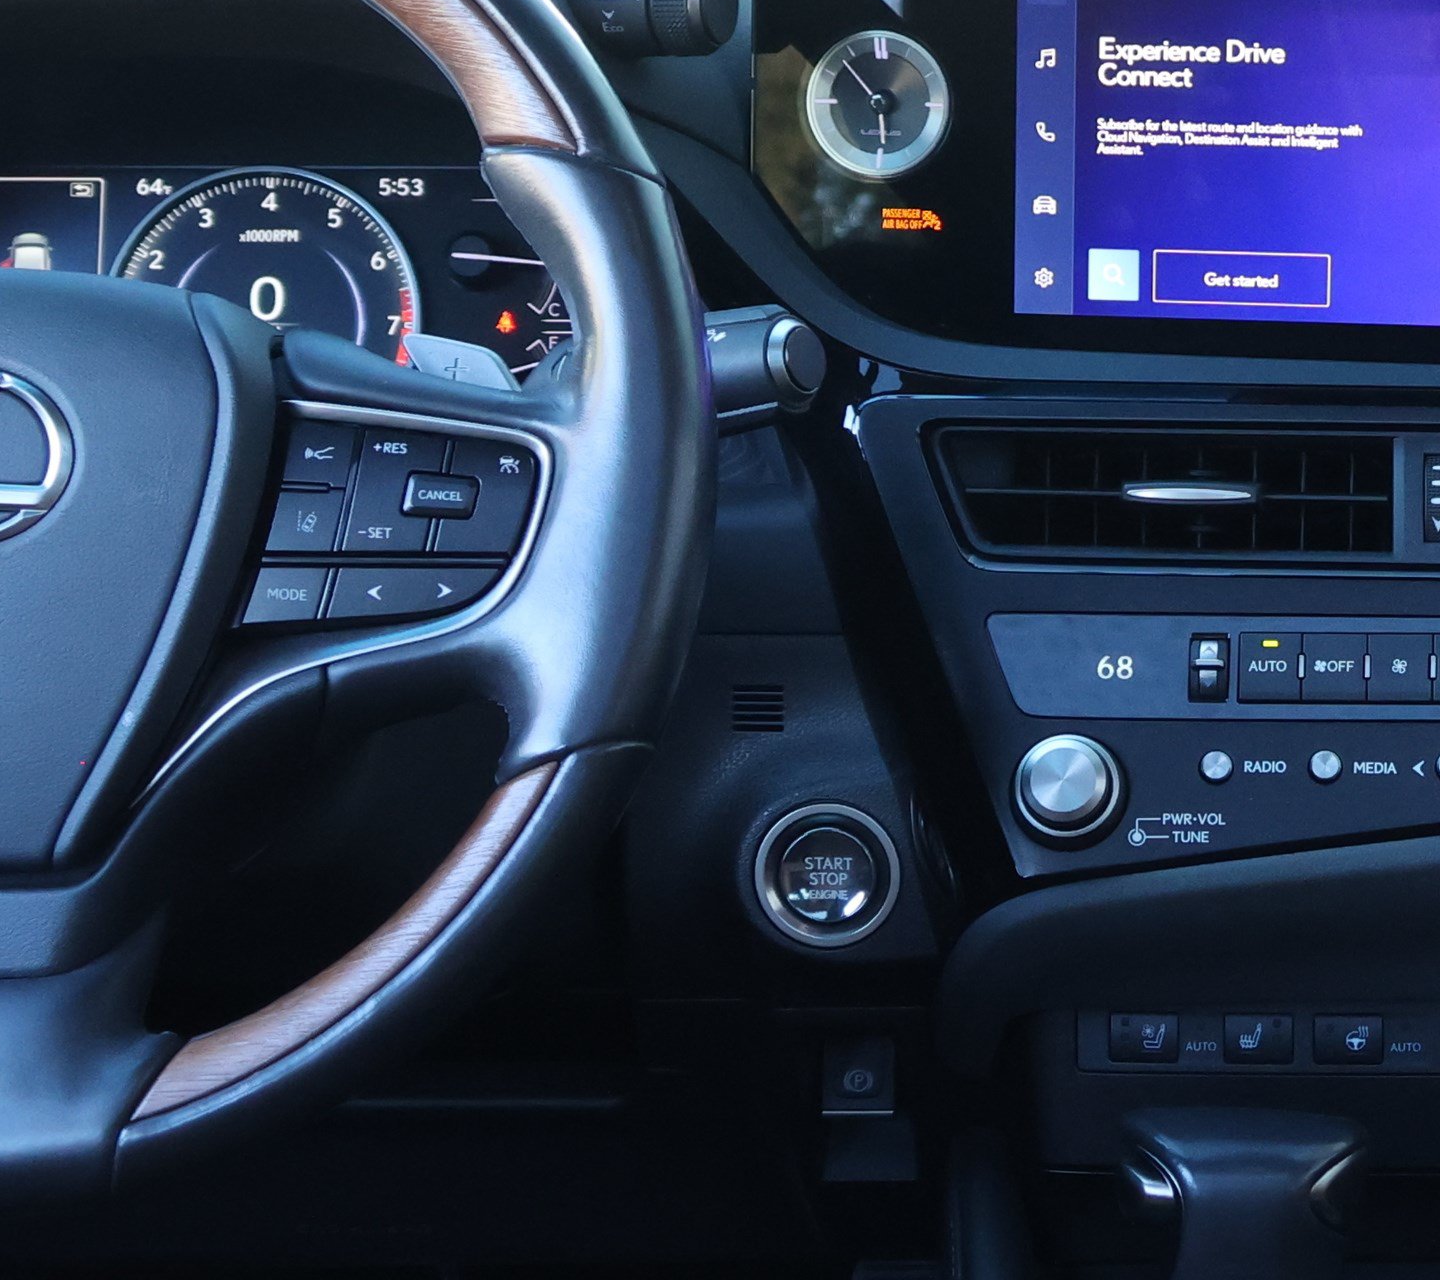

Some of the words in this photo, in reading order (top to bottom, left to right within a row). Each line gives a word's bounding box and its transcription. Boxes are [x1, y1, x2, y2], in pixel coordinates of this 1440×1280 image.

[1098, 36, 1221, 65] Experience
[1225, 39, 1286, 64] Drive
[1097, 62, 1193, 88] Connect
[1097, 117, 1145, 132] Subscribe
[1145, 119, 1160, 132] for
[1161, 119, 1178, 132] the
[1179, 120, 1207, 133] latest
[1208, 122, 1235, 134] route
[1236, 122, 1255, 134] and
[1255, 122, 1294, 135] location
[1295, 123, 1339, 138] guidance
[1339, 124, 1363, 137] with
[1097, 130, 1127, 143] Cloud
[1184, 133, 1240, 146] Destination
[1240, 134, 1270, 147] Assist
[1271, 134, 1290, 147] and
[1291, 135, 1339, 150] Intelligent
[378, 178, 424, 196] 5:53
[261, 192, 279, 211] 4
[198, 208, 215, 228] 3
[327, 209, 342, 228] 5
[882, 208, 921, 219] PASSENGER
[882, 219, 895, 230] AIR
[896, 219, 909, 230] BAG
[909, 220, 923, 230] OFF
[238, 229, 299, 243] x1000RPM
[148, 250, 165, 270] 2
[371, 251, 386, 270] 6
[1203, 271, 1231, 287] Get
[1232, 273, 1278, 288] started
[250, 276, 285, 321] 0
[548, 303, 560, 317] C
[387, 315, 402, 335] 7
[418, 490, 463, 503] CANCEL
[267, 588, 307, 601] MODE
[1097, 655, 1134, 681] 68
[1248, 659, 1287, 673] AUTO
[1327, 660, 1354, 674] OFF
[1243, 759, 1287, 775] RADIO
[1353, 760, 1397, 775] MEDIA
[1173, 830, 1209, 844] TUNE
[804, 856, 853, 871] START
[809, 872, 848, 887] STOP
[808, 889, 848, 901] ENGINE
[1185, 1039, 1218, 1052] AUTO
[1390, 1040, 1422, 1053] AUTO
